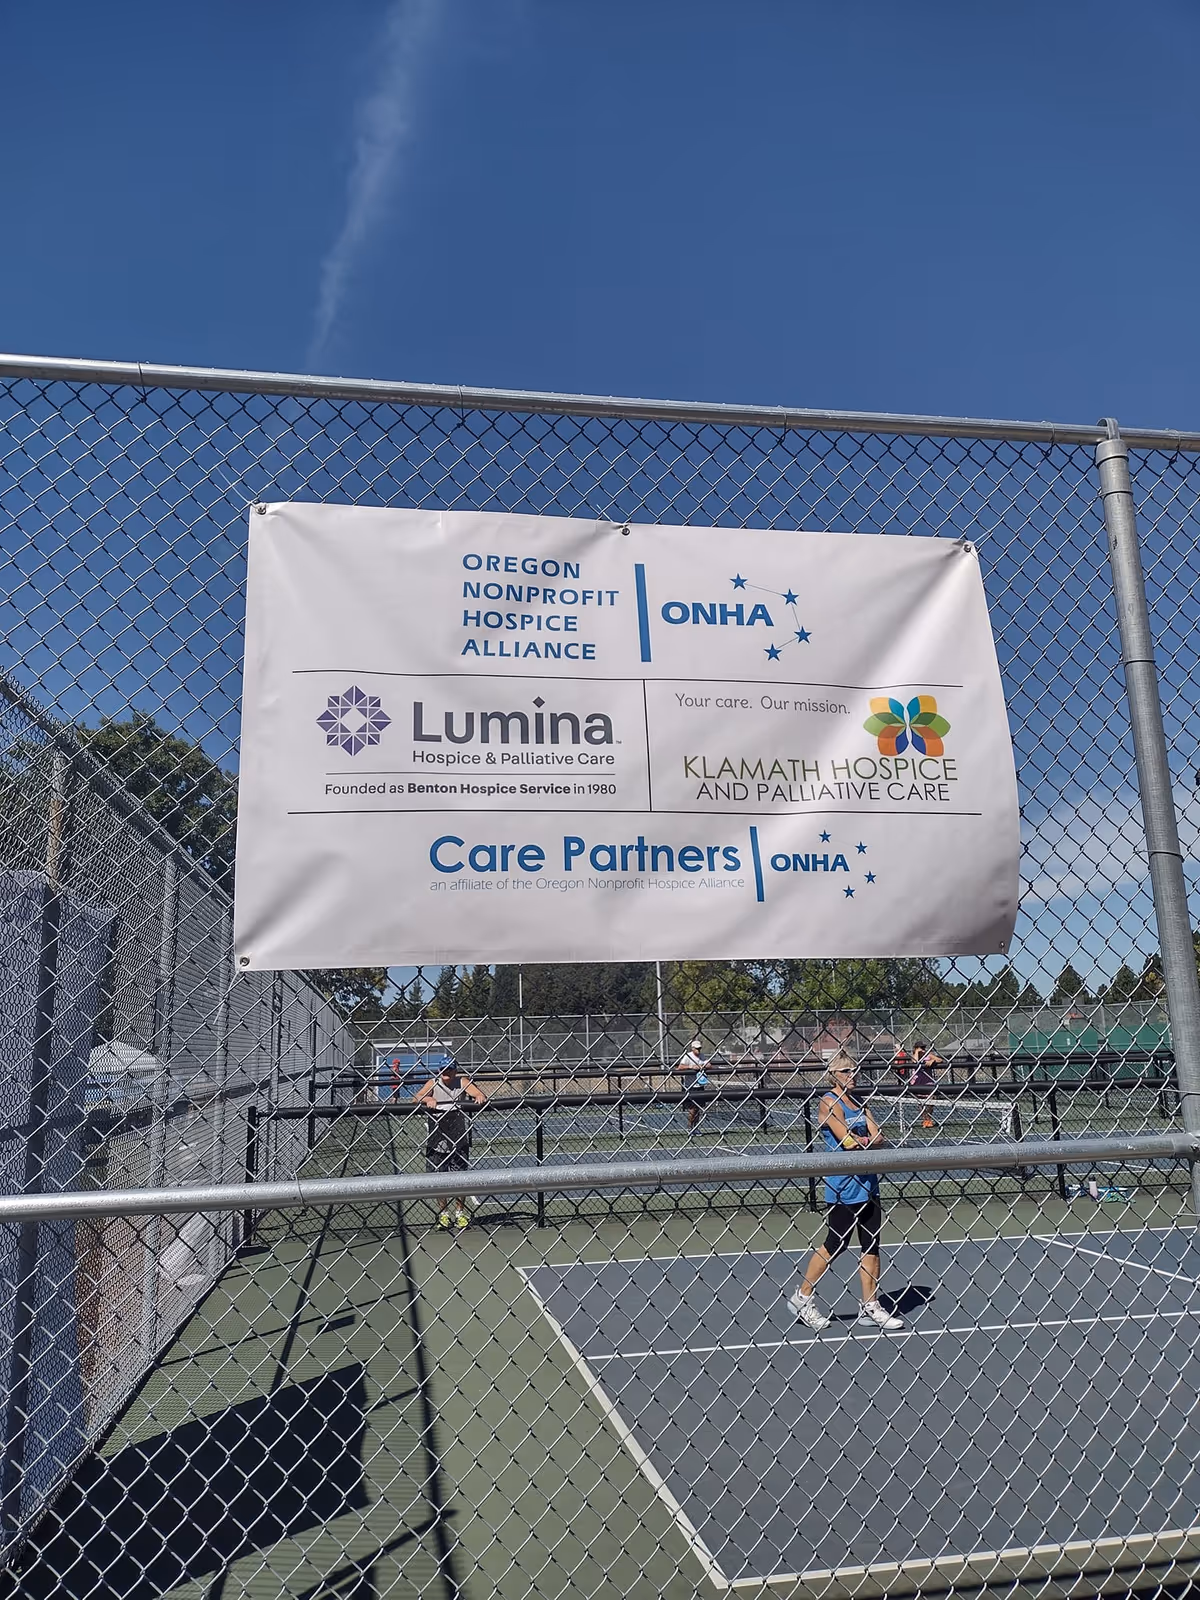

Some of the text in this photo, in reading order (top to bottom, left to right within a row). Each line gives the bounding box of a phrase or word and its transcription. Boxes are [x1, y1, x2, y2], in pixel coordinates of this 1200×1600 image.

[462, 553, 581, 579] OREGON
[462, 581, 620, 607] NONPROFIT
[462, 609, 578, 632] HOSPICE
[660, 600, 775, 628] ONHA
[460, 638, 596, 661] ALLIANCE
[674, 692, 851, 715] Your care. Our mission.
[412, 695, 614, 746] Lumina
[412, 749, 615, 767] Hospice & Palliative Care
[683, 755, 959, 782] KLAMATH HOSPICE
[324, 781, 617, 797] Founded as Benton Hospice Service in 1980
[695, 779, 951, 803] AND PALLIATIVE CARE
[429, 835, 742, 874] Care Partners
[770, 853, 851, 873] ONHA
[429, 876, 745, 892] an affiliate of the Oregon Nonprofit Hospice Alliance
